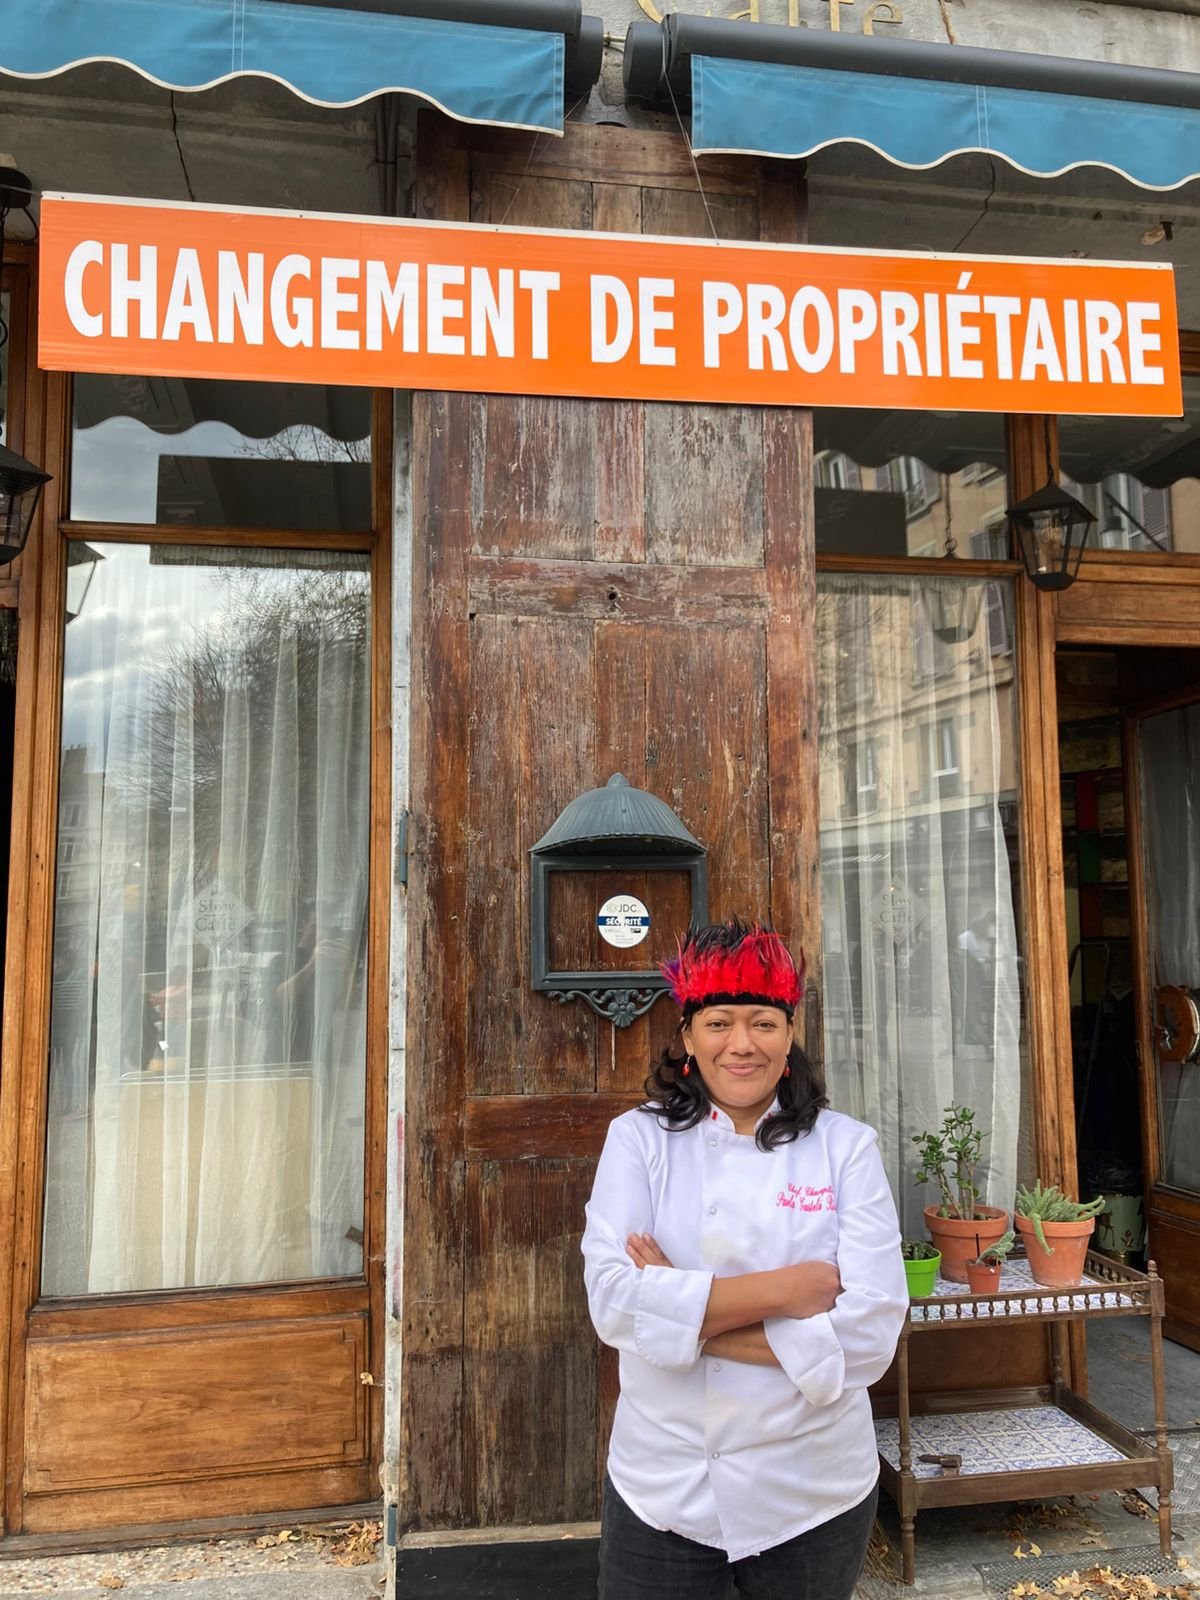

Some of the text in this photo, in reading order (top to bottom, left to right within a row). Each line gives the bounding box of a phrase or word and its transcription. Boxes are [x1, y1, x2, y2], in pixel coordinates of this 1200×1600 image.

[64, 239, 1165, 385] CHANGEMENT DE PROPRIÉTAIRE
[198, 899, 236, 913] Slow
[619, 903, 637, 913] JDC
[605, 916, 642, 926] SÉCRITÉ
